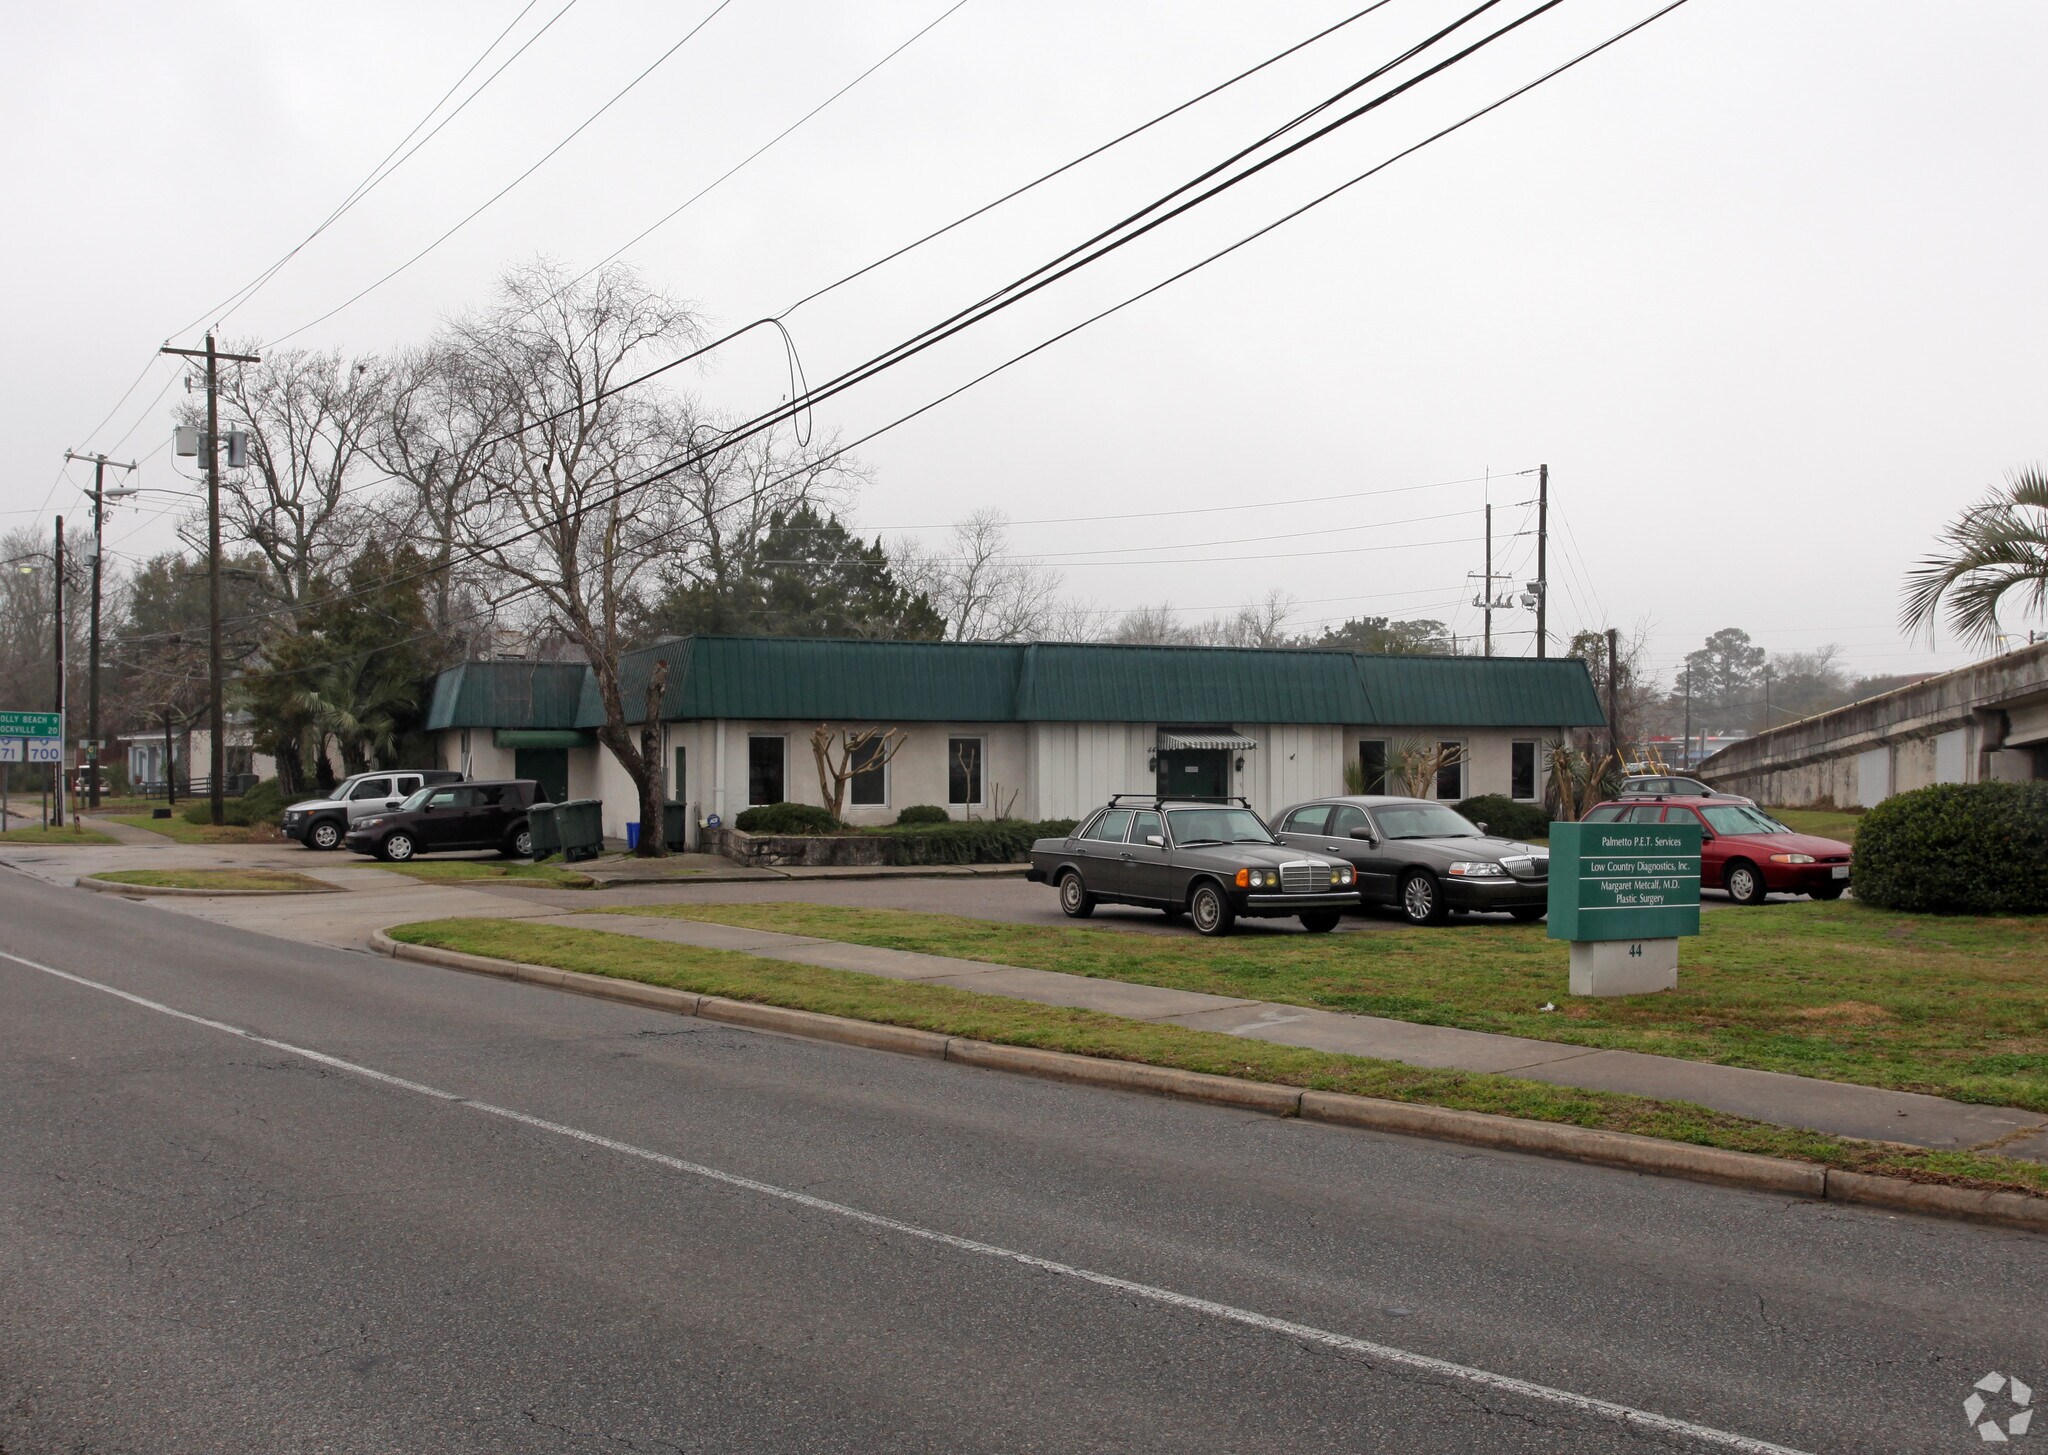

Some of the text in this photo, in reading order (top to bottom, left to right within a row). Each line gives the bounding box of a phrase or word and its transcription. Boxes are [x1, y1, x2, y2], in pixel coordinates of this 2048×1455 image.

[31, 748, 58, 759] 700
[1602, 837, 1681, 846] Palmetto P.E.T. Services
[1591, 861, 1691, 873] Low Country Diagnostics, Inc.
[1601, 880, 1680, 893] Margaret Metcalf, M.D.
[1616, 894, 1664, 905] Plastic Surgery
[1629, 944, 1642, 957] 44
